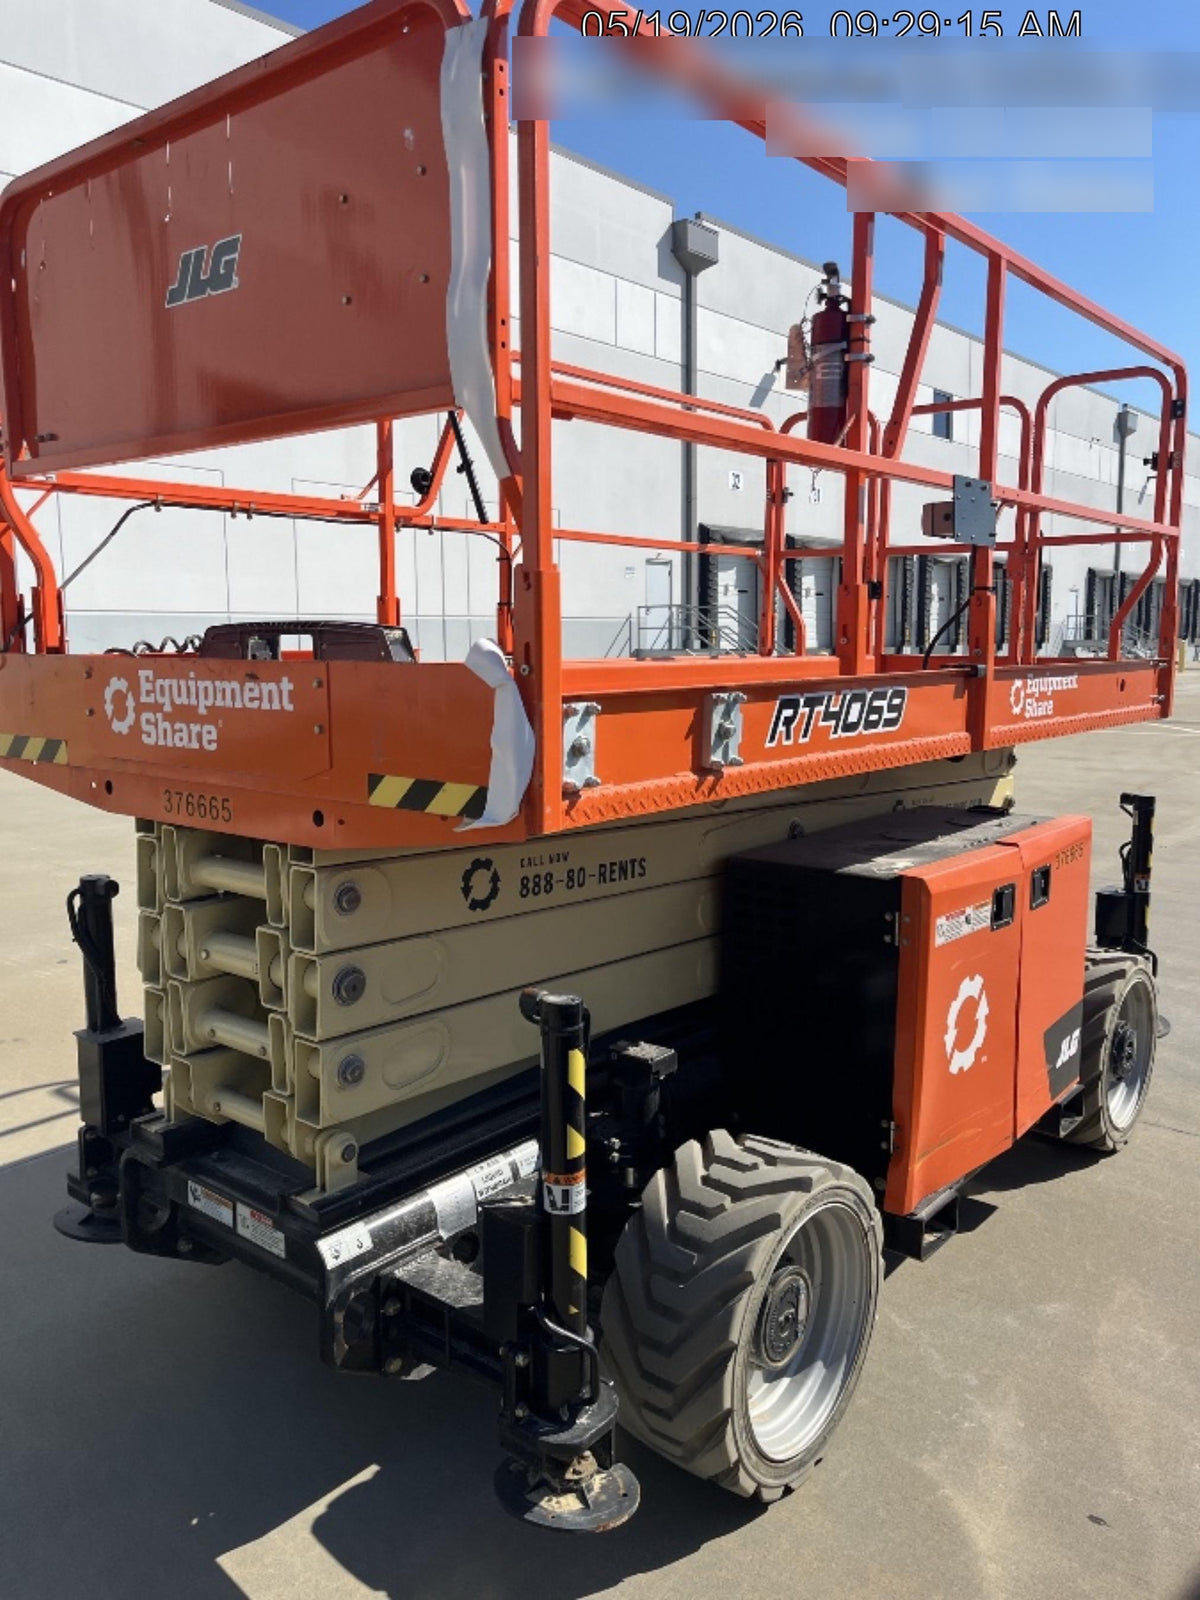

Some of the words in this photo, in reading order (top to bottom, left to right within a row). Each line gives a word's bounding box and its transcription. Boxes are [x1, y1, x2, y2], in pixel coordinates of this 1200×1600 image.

[165, 233, 242, 308] JLG
[138, 669, 295, 715] Equipment
[1025, 672, 1079, 697] Equipment
[764, 686, 908, 748] RT4069
[1024, 698, 1054, 719] Share
[140, 712, 218, 751] Share
[163, 789, 232, 823] 376665
[519, 857, 647, 898] 888-80-RENTS
[520, 856, 545, 868] CALL
[549, 851, 570, 863] NOW
[1055, 1027, 1081, 1069] JLG
